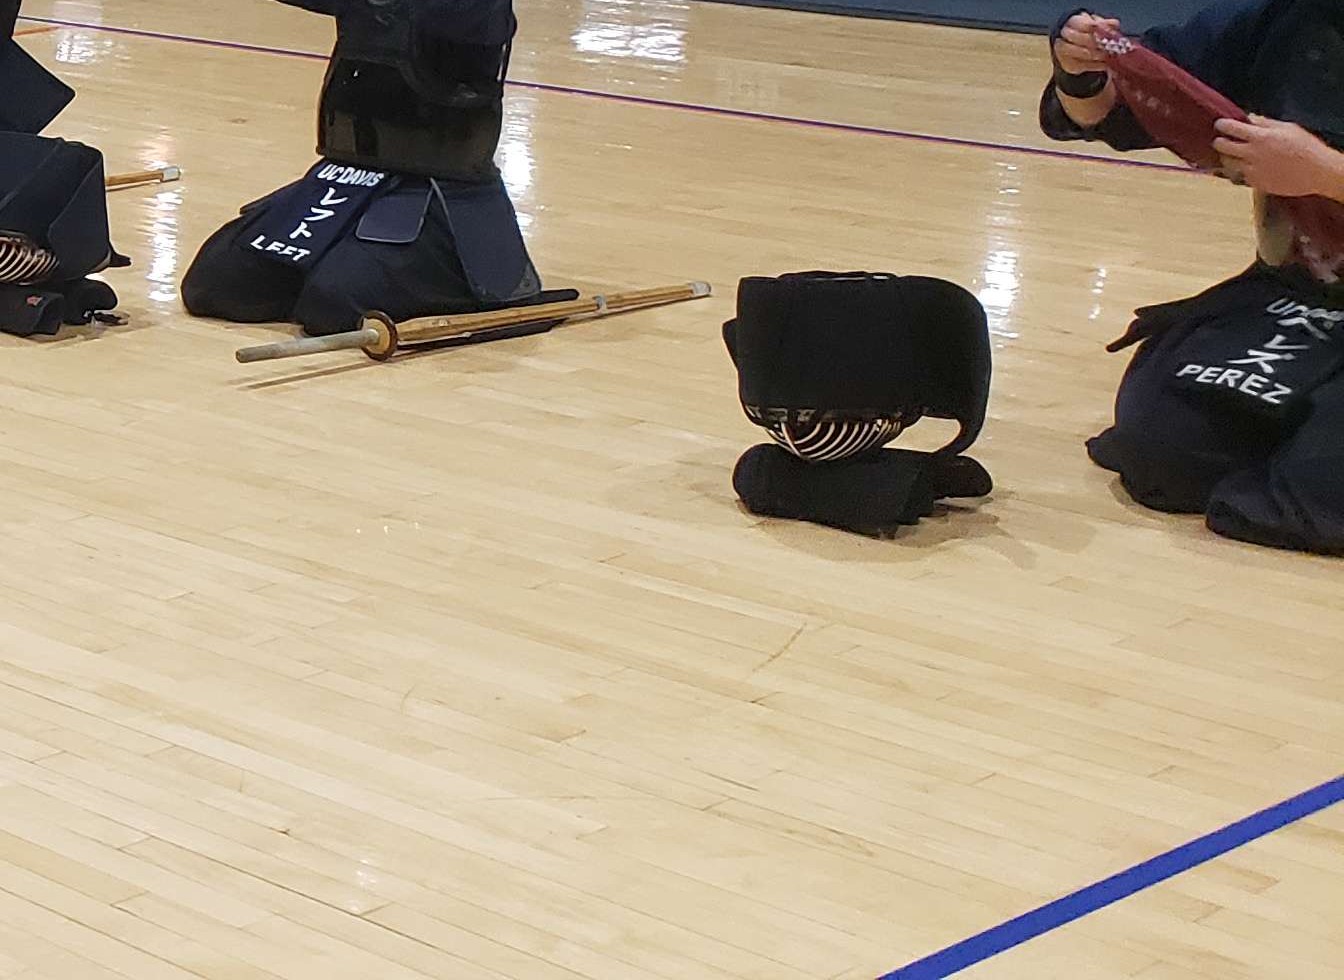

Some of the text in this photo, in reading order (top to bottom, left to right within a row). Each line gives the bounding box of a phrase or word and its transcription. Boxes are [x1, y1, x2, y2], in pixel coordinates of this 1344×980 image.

[289, 187, 349, 239] レフト
[1175, 364, 1293, 404] PEREZ
